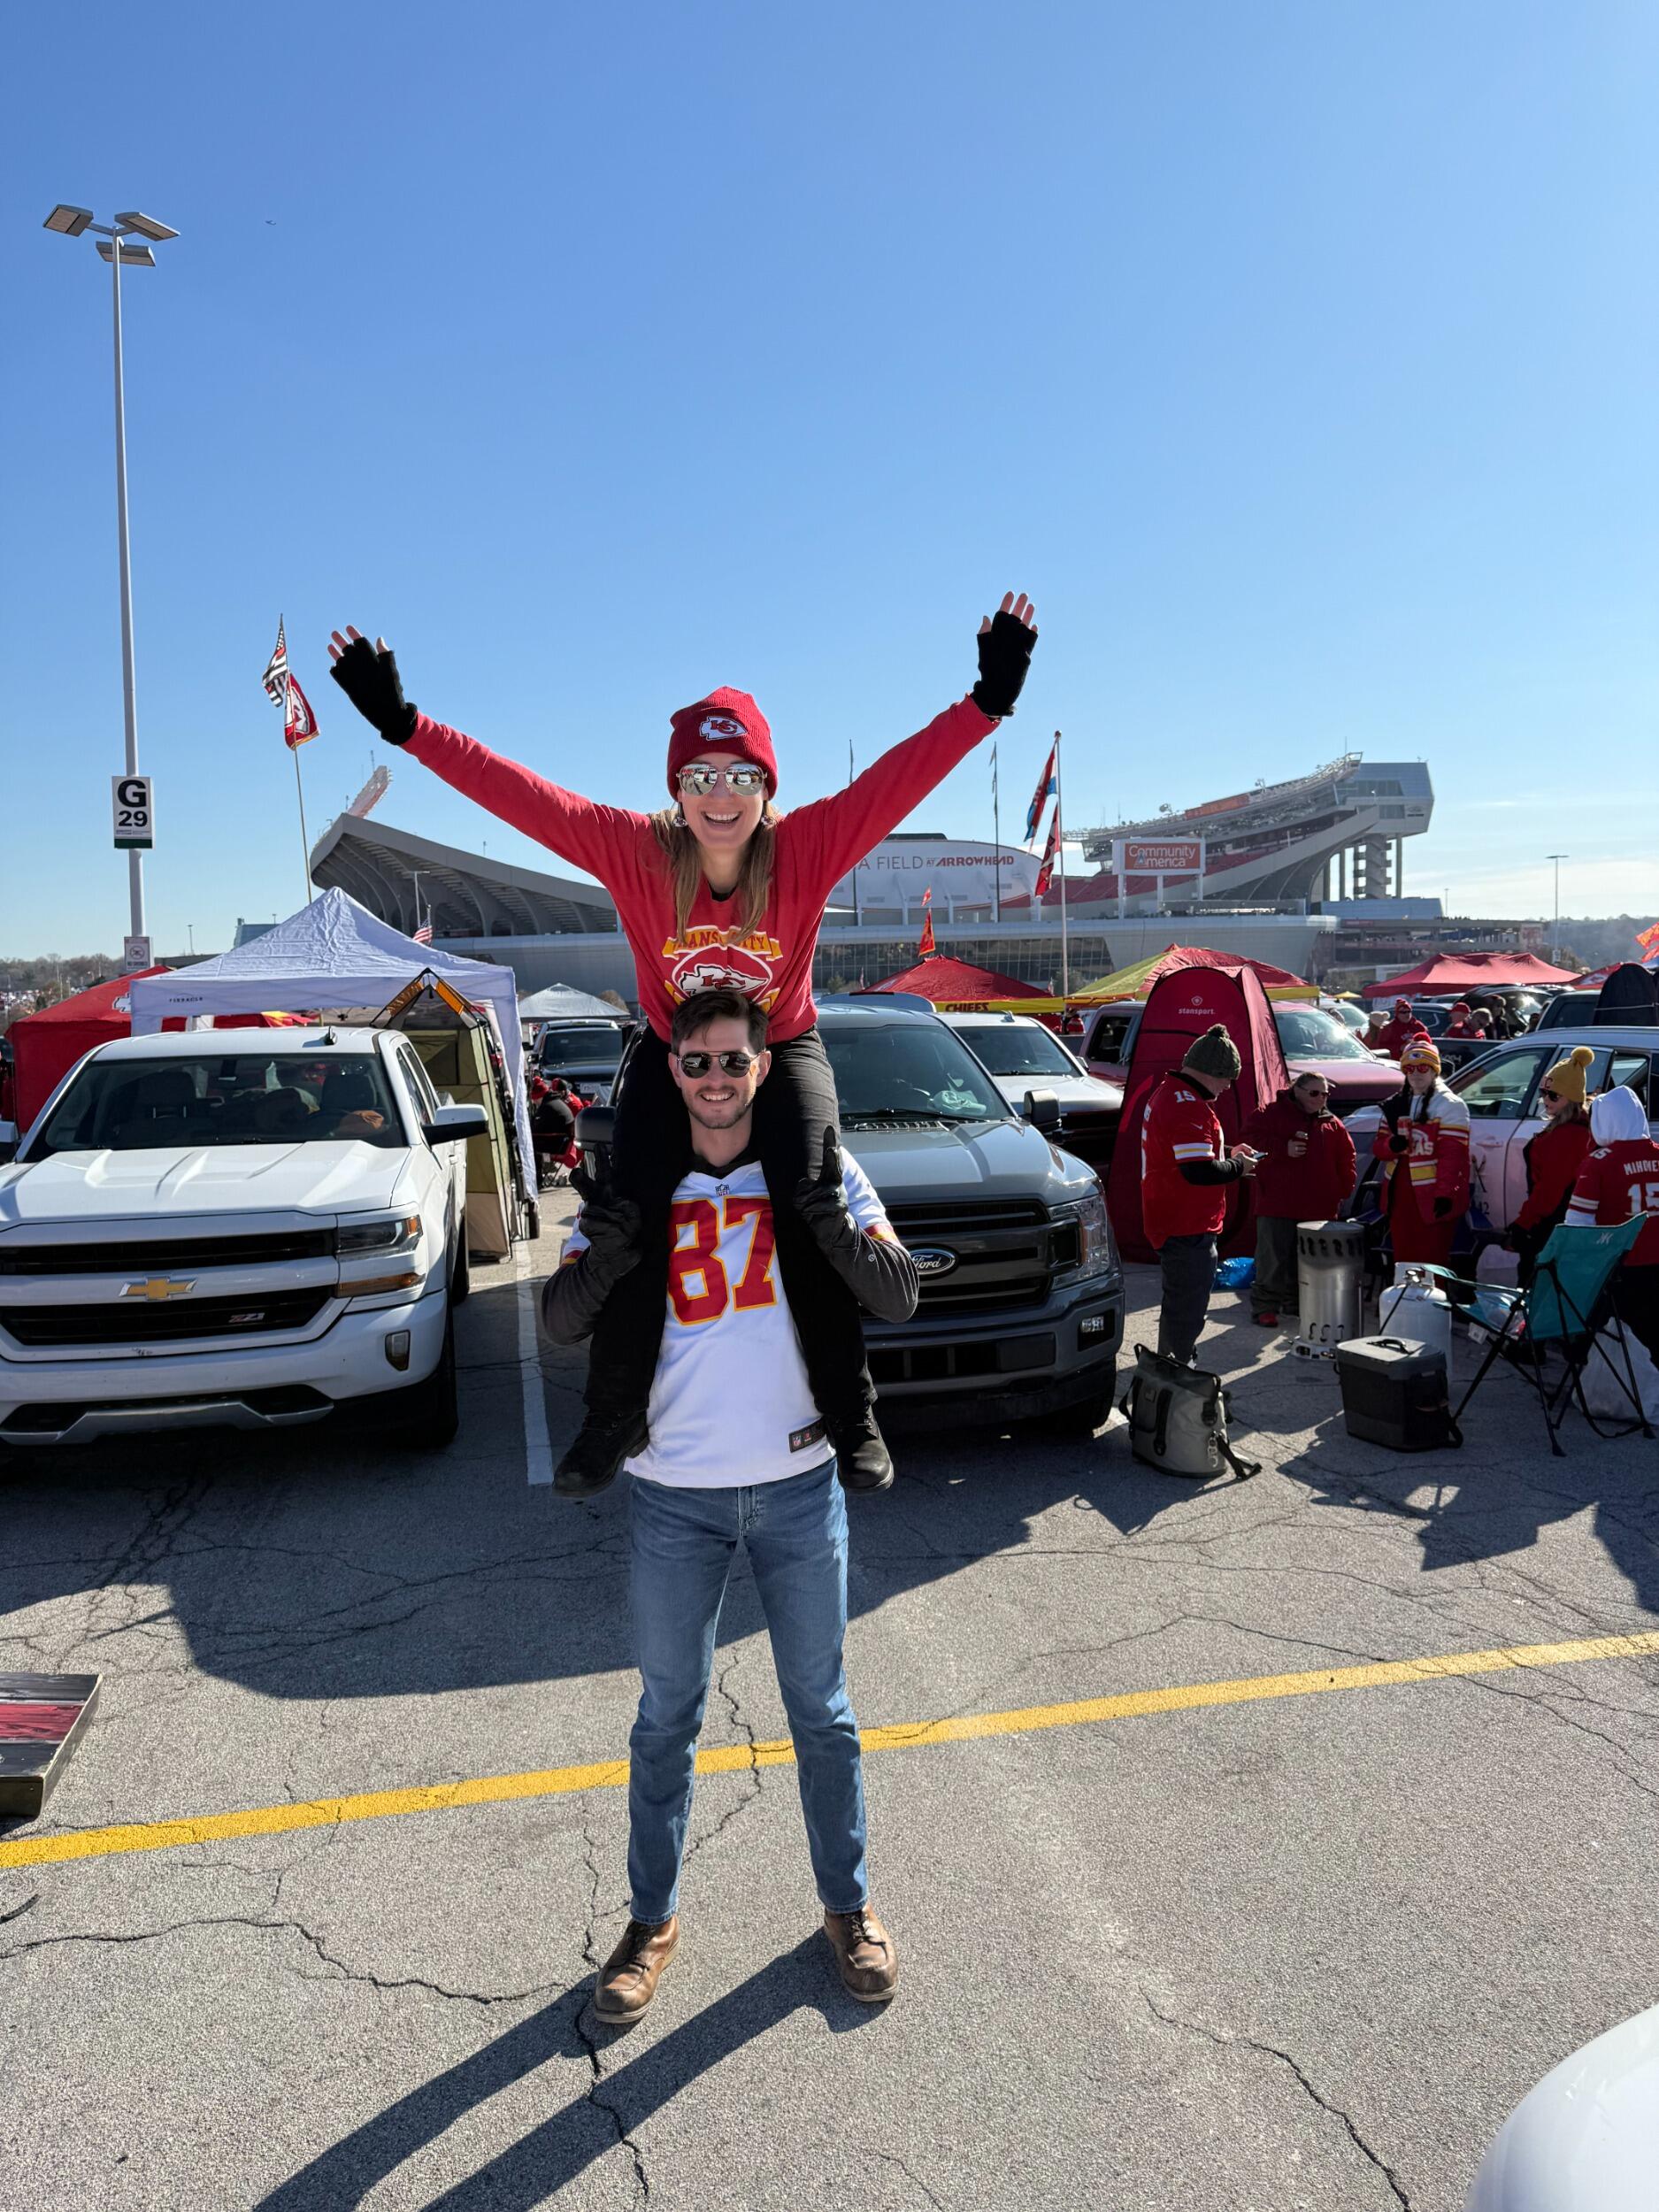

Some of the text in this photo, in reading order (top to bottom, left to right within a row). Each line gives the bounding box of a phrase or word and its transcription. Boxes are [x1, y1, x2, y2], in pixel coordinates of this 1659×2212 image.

[118, 780, 147, 808] G
[119, 810, 148, 827] 29
[1129, 845, 1195, 859] Community
[877, 856, 923, 870] FIELD
[935, 856, 1014, 867] ARROWHEAD
[1174, 1090, 1196, 1102] 15
[1624, 1160, 1659, 1175] MAHOME
[668, 1195, 779, 1325] 87
[911, 1255, 941, 1269] Ford
